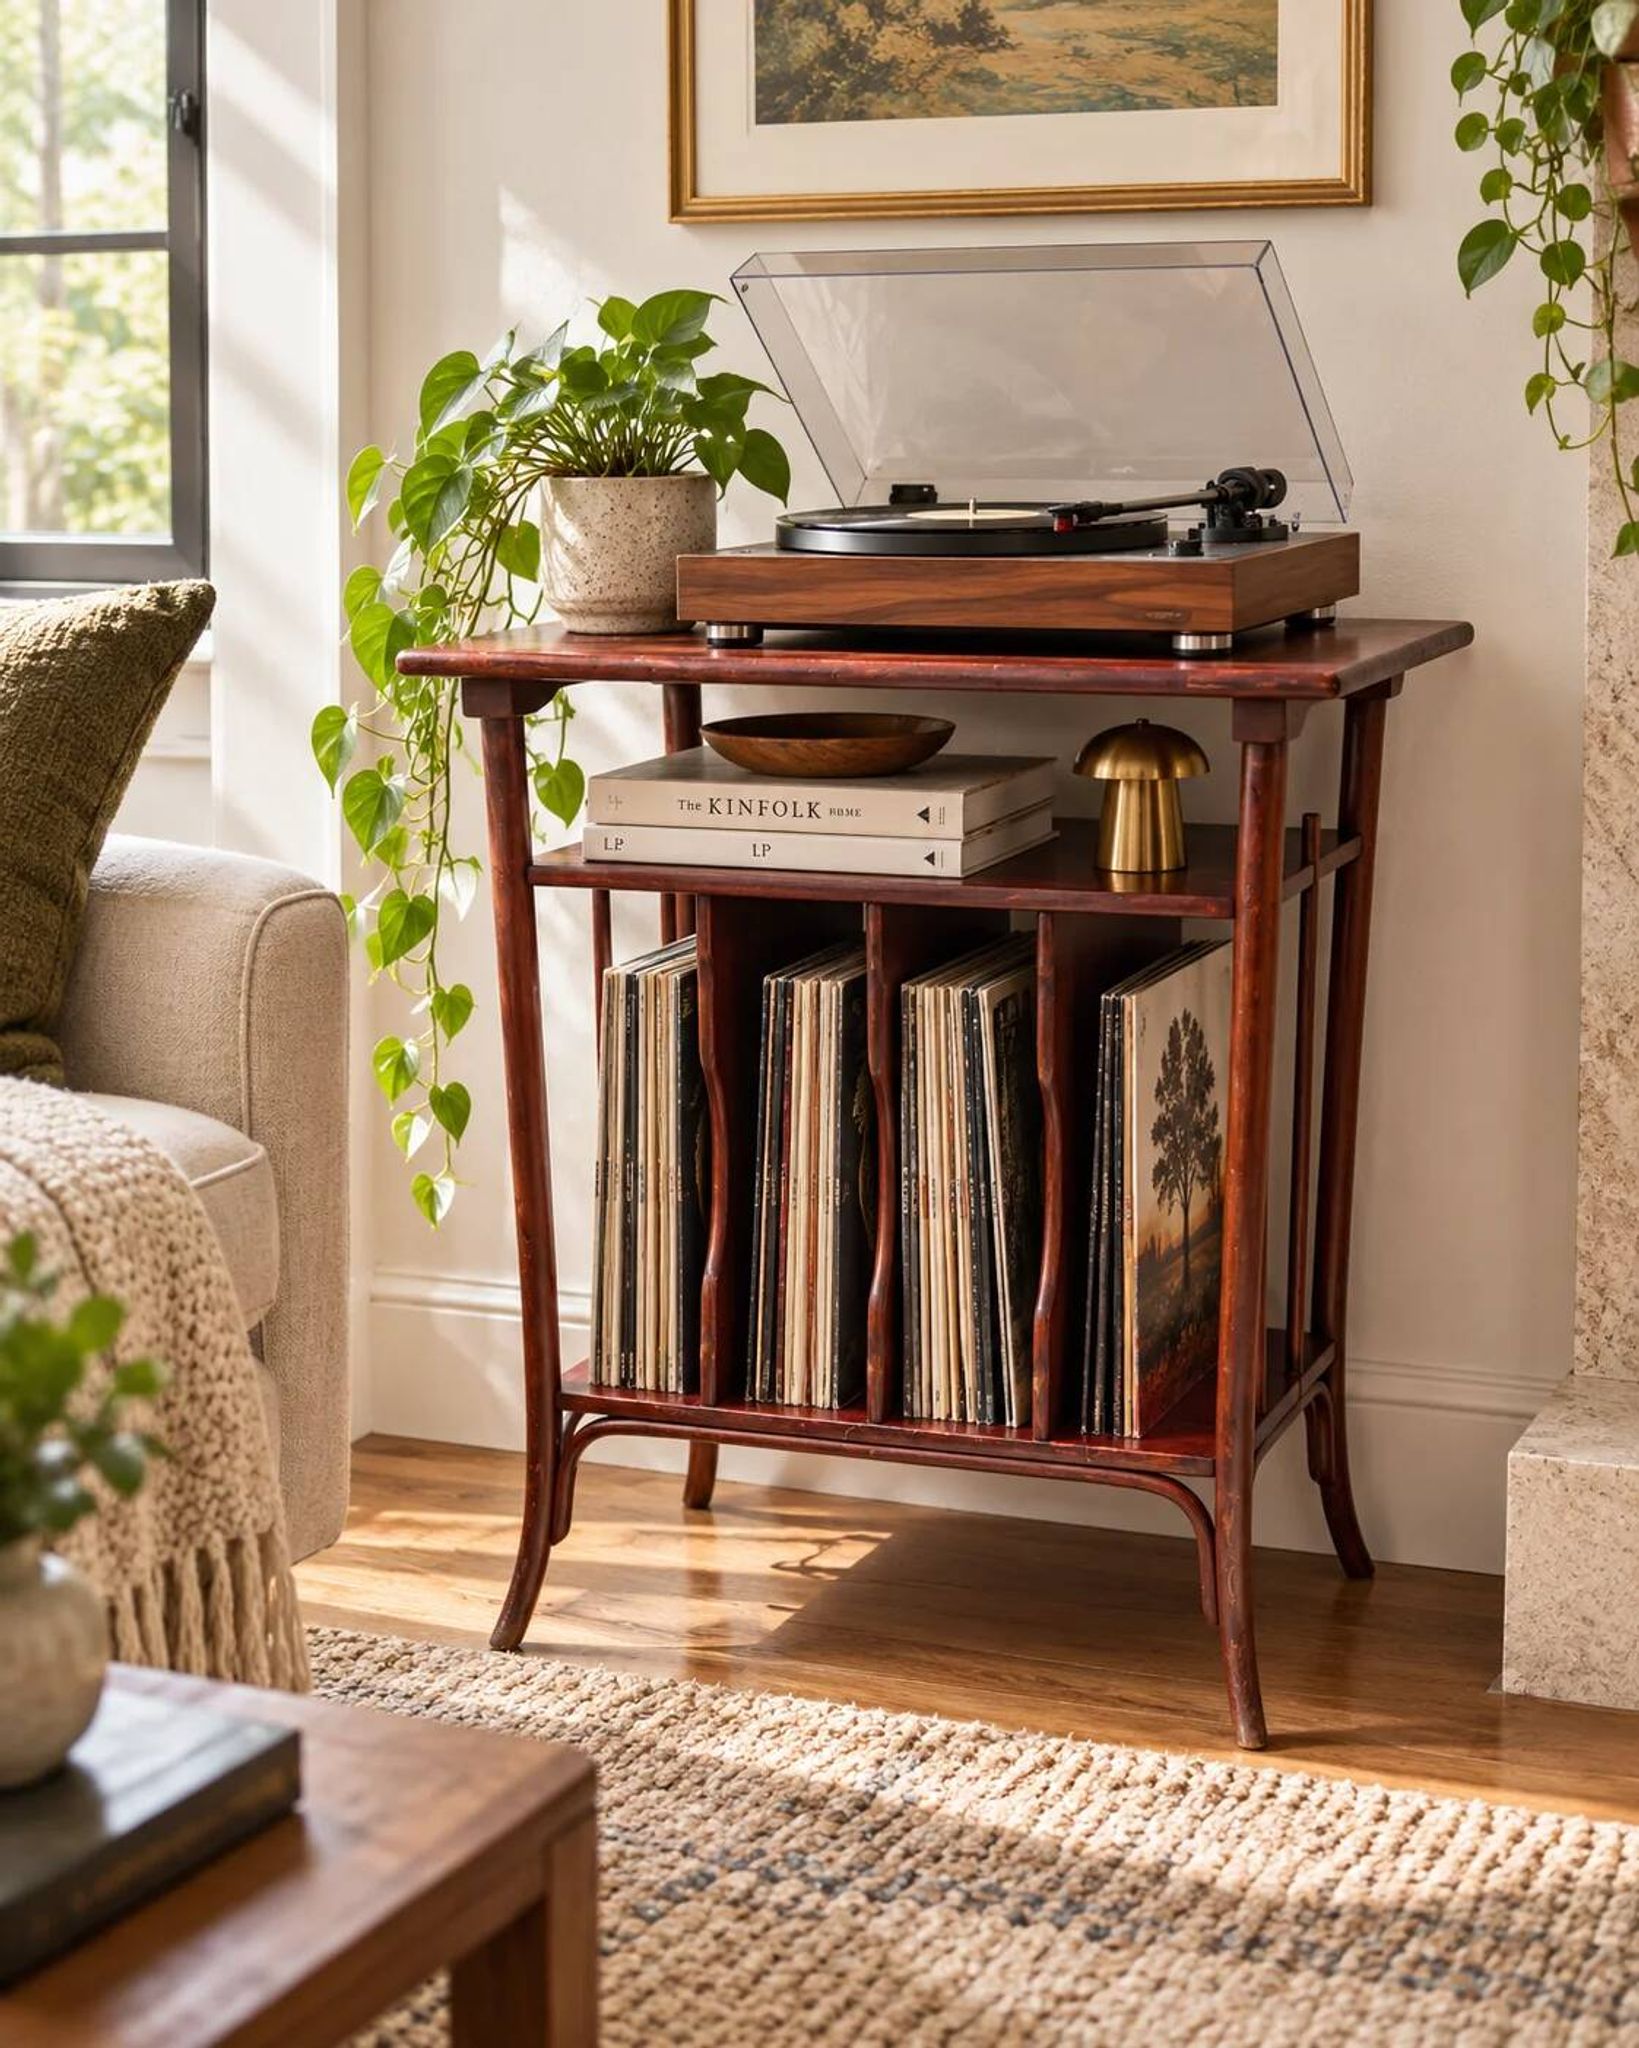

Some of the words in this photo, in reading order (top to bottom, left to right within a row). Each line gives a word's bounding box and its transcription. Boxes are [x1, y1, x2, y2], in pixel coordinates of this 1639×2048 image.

[678, 799, 702, 811] The
[709, 798, 822, 820] KINFOLK
[752, 843, 772, 858] LP
